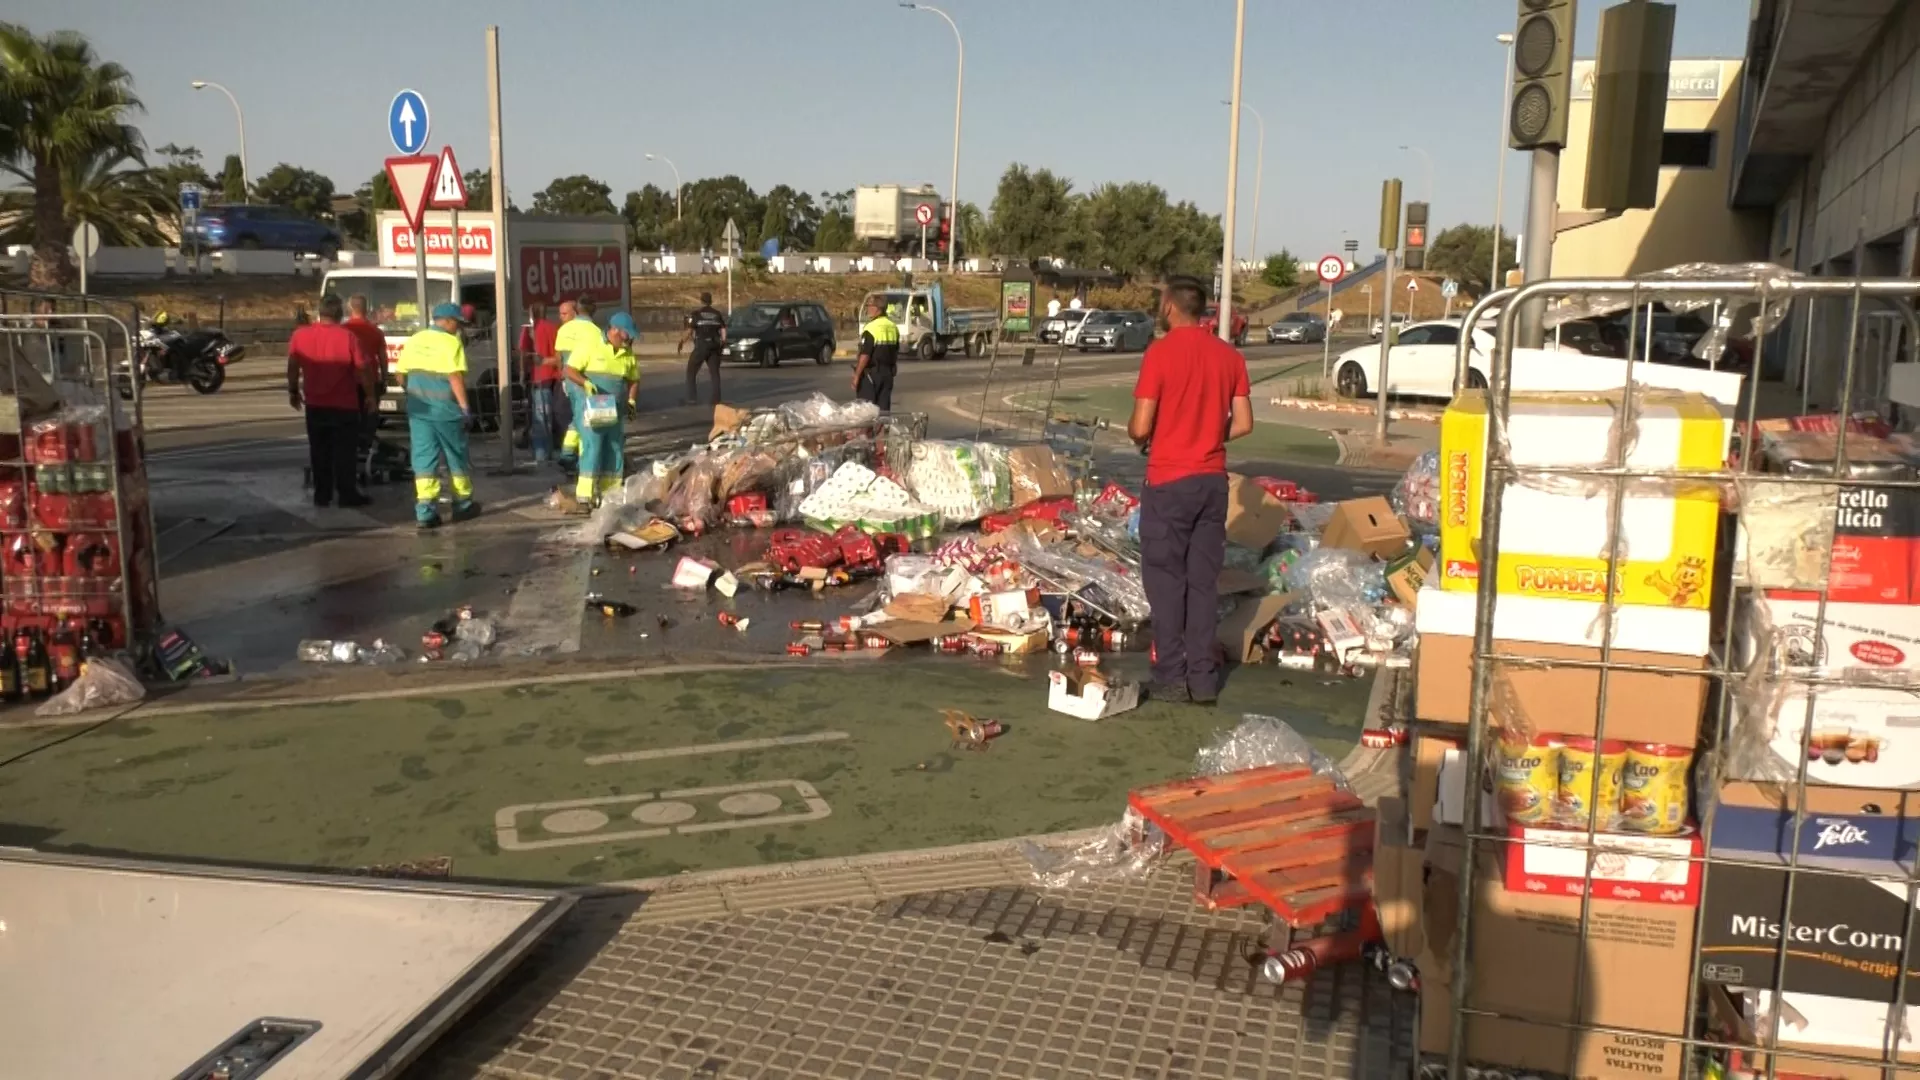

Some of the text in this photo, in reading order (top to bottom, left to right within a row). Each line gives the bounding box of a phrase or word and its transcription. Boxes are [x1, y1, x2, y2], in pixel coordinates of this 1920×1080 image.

[396, 228, 415, 249] el
[526, 246, 618, 302] el jamón
[1839, 489, 1888, 508] rella
[1837, 508, 1882, 528] licia
[1731, 914, 1903, 950] MisterCorn
[1603, 1046, 1664, 1062] BOLACHAS
[1606, 1058, 1662, 1073] GALLETAS
